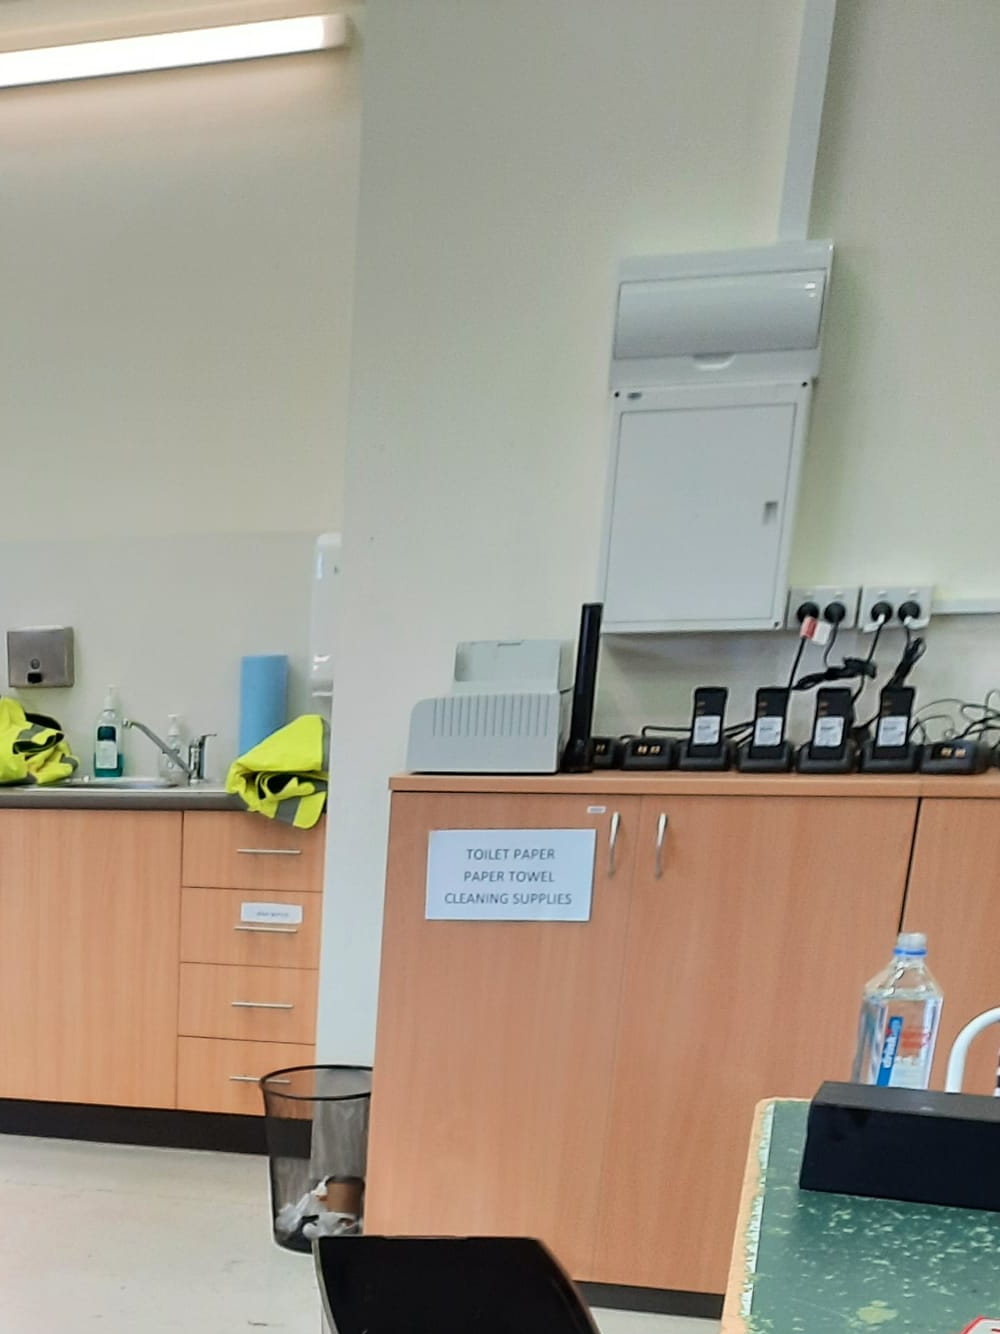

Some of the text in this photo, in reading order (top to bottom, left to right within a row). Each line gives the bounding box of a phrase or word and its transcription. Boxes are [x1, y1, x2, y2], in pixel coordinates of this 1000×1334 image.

[466, 848, 556, 861] TOILET PAPER
[463, 870, 556, 883] PAPER TOWEL
[443, 892, 573, 905] CLEANING SUPPLIES
